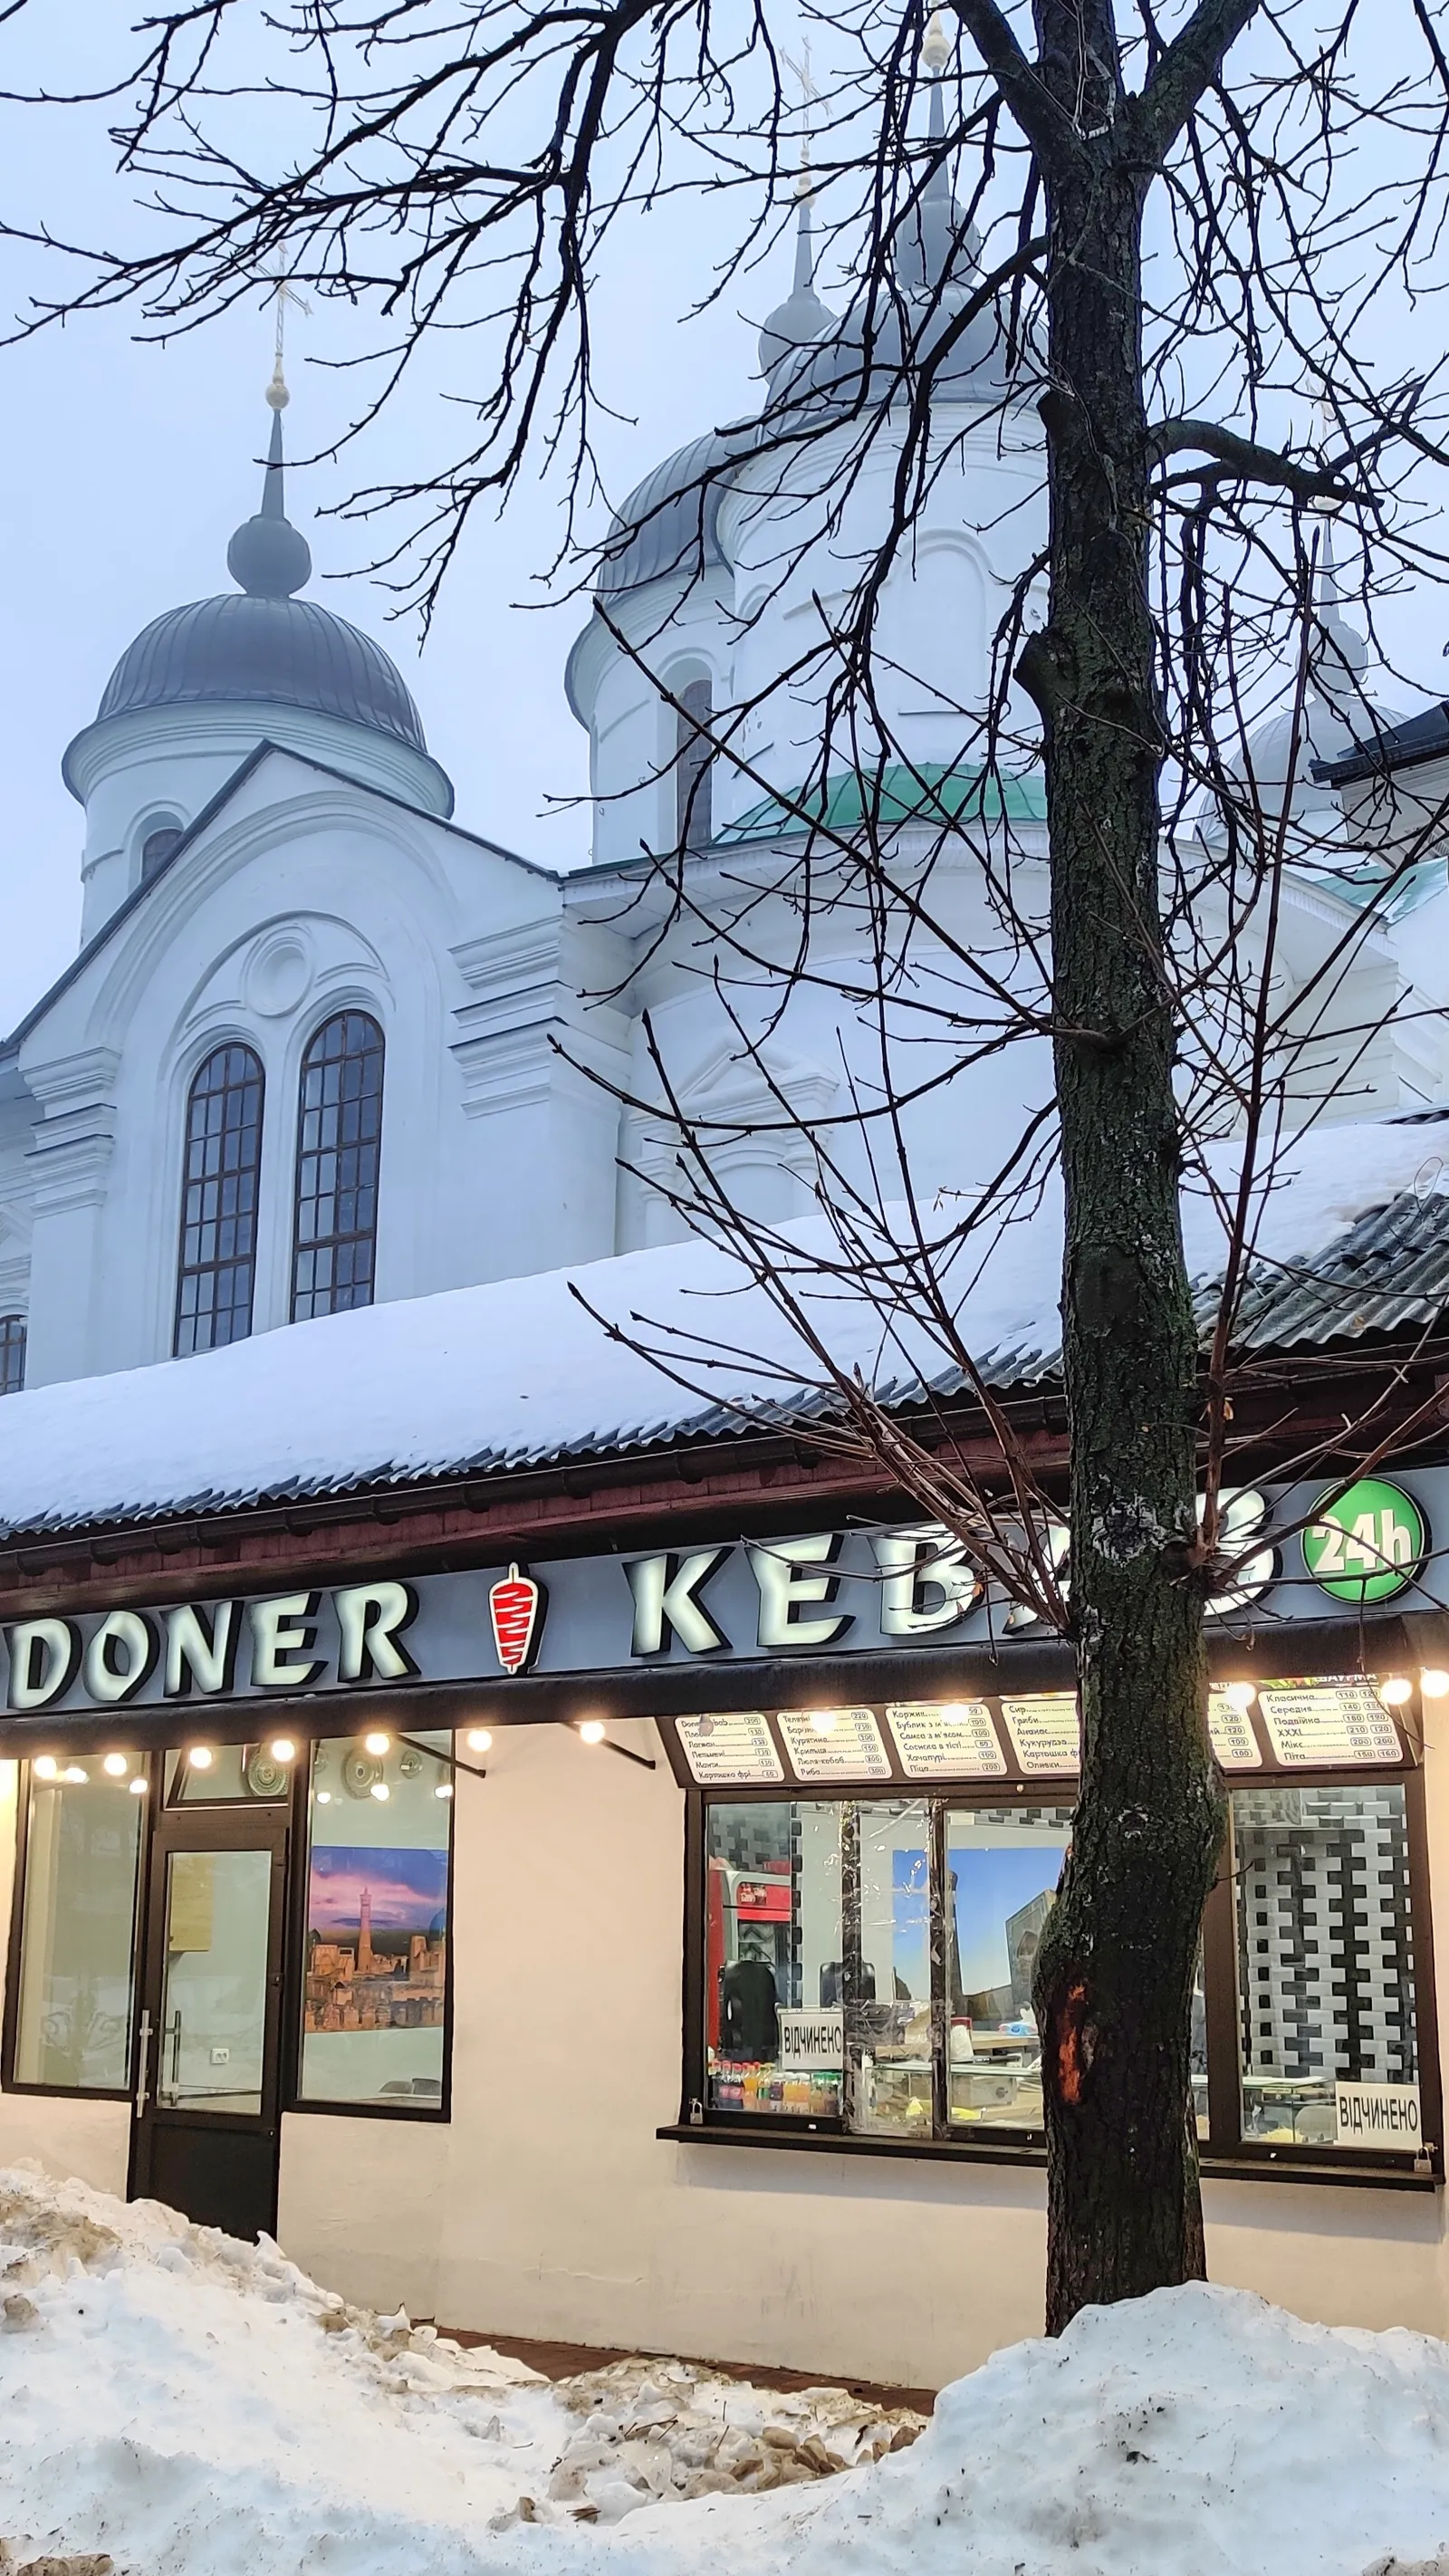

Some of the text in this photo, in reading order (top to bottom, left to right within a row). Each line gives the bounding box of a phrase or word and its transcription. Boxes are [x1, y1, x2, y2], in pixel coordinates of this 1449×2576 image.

[1312, 1509, 1412, 1572] 24h
[5, 1582, 421, 1709] DONER
[1009, 1706, 1026, 1716] Сир
[1281, 1741, 1303, 1749] Мікс
[1284, 1752, 1305, 1761] Піта
[1339, 2096, 1417, 2135] ВІДЧИНЕНО
